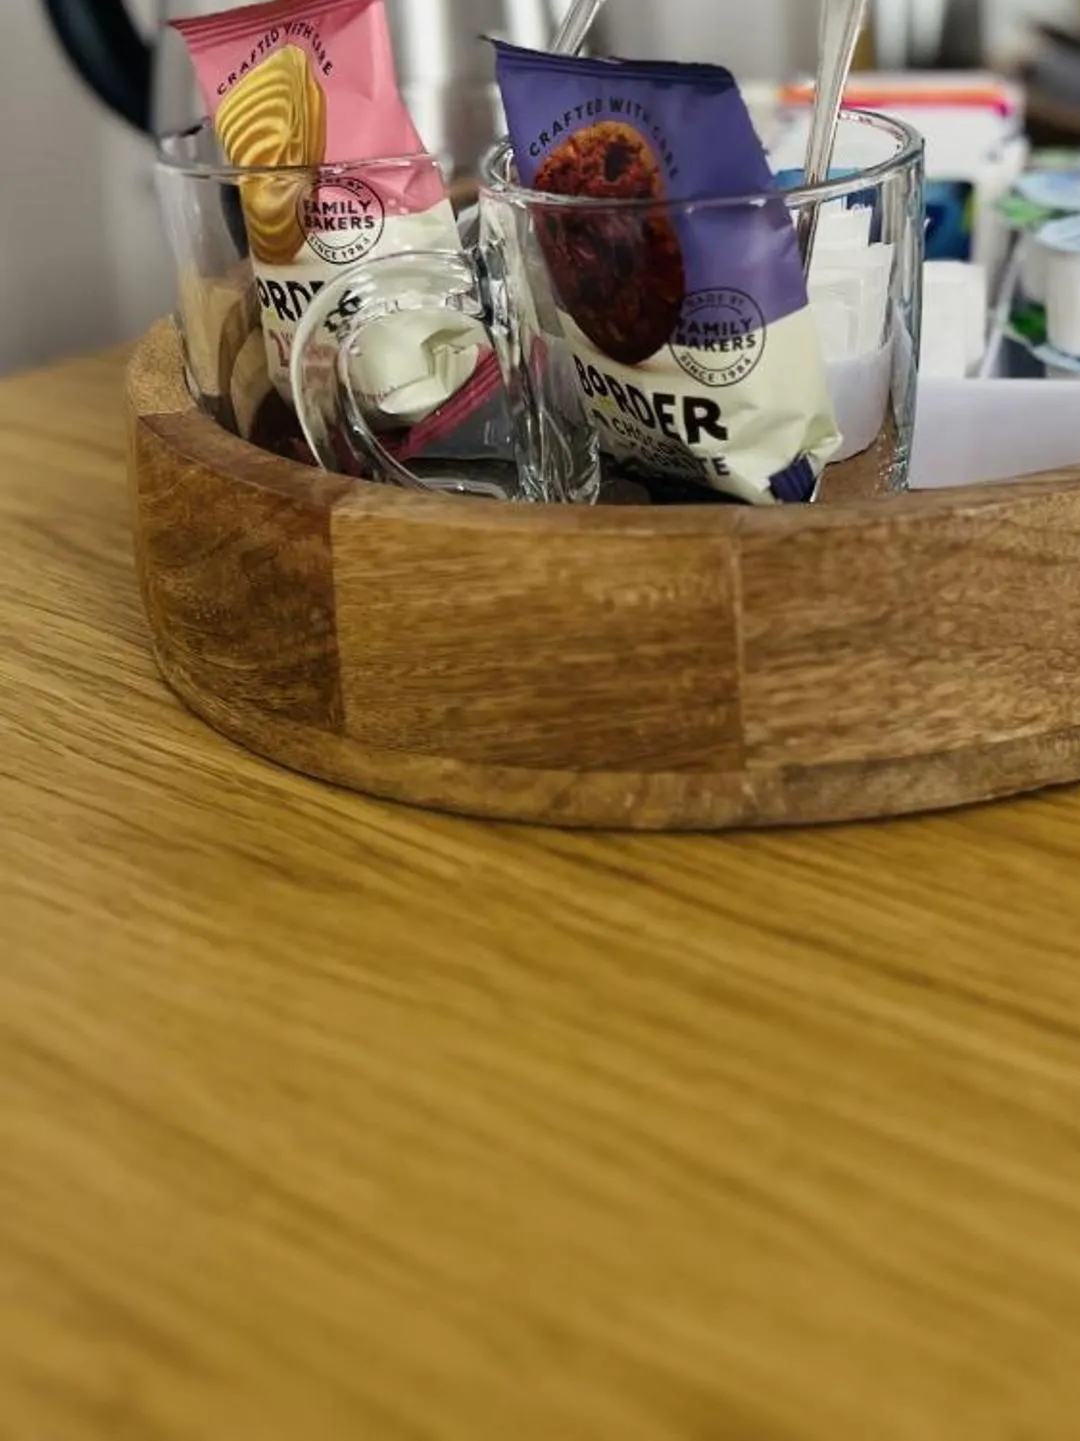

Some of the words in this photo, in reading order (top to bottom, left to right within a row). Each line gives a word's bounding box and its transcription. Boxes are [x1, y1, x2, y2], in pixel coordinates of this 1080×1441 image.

[283, 21, 315, 40] WITH
[529, 97, 603, 157] CRAFTED
[609, 96, 650, 124] WITH
[303, 199, 372, 215] FAMILY
[303, 214, 375, 231] BAKERS
[676, 333, 757, 353] BAKERS
[680, 354, 714, 383] SINCE
[573, 354, 729, 445] BORDER
